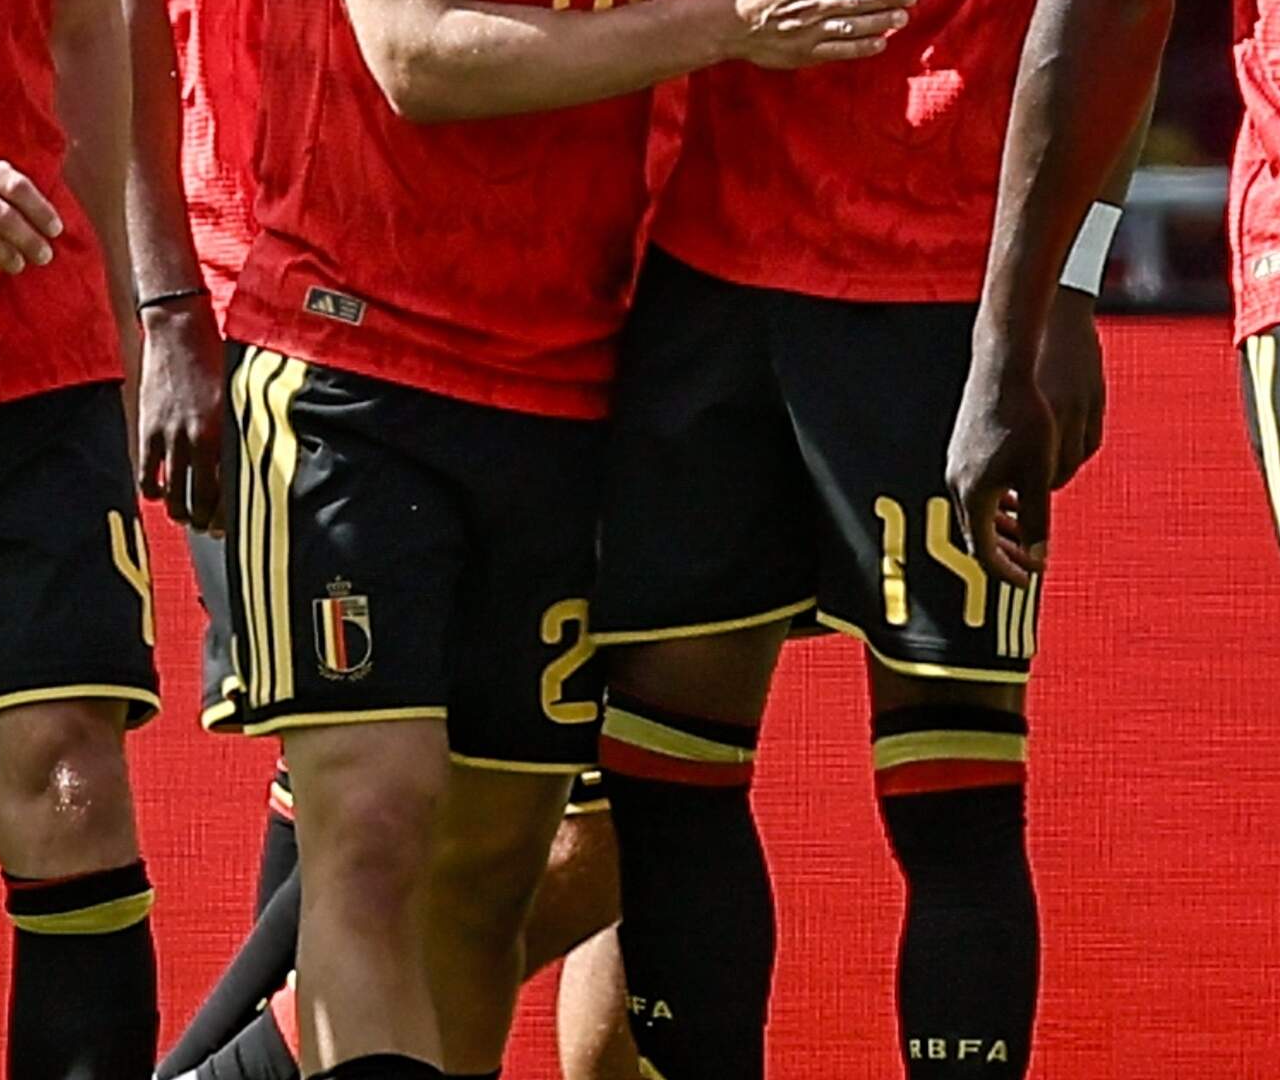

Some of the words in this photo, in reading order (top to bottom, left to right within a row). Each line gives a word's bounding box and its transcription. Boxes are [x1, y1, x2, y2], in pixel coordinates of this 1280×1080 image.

[107, 509, 155, 647] 4
[874, 495, 987, 628] 14
[909, 1038, 1008, 1062] RBFA
